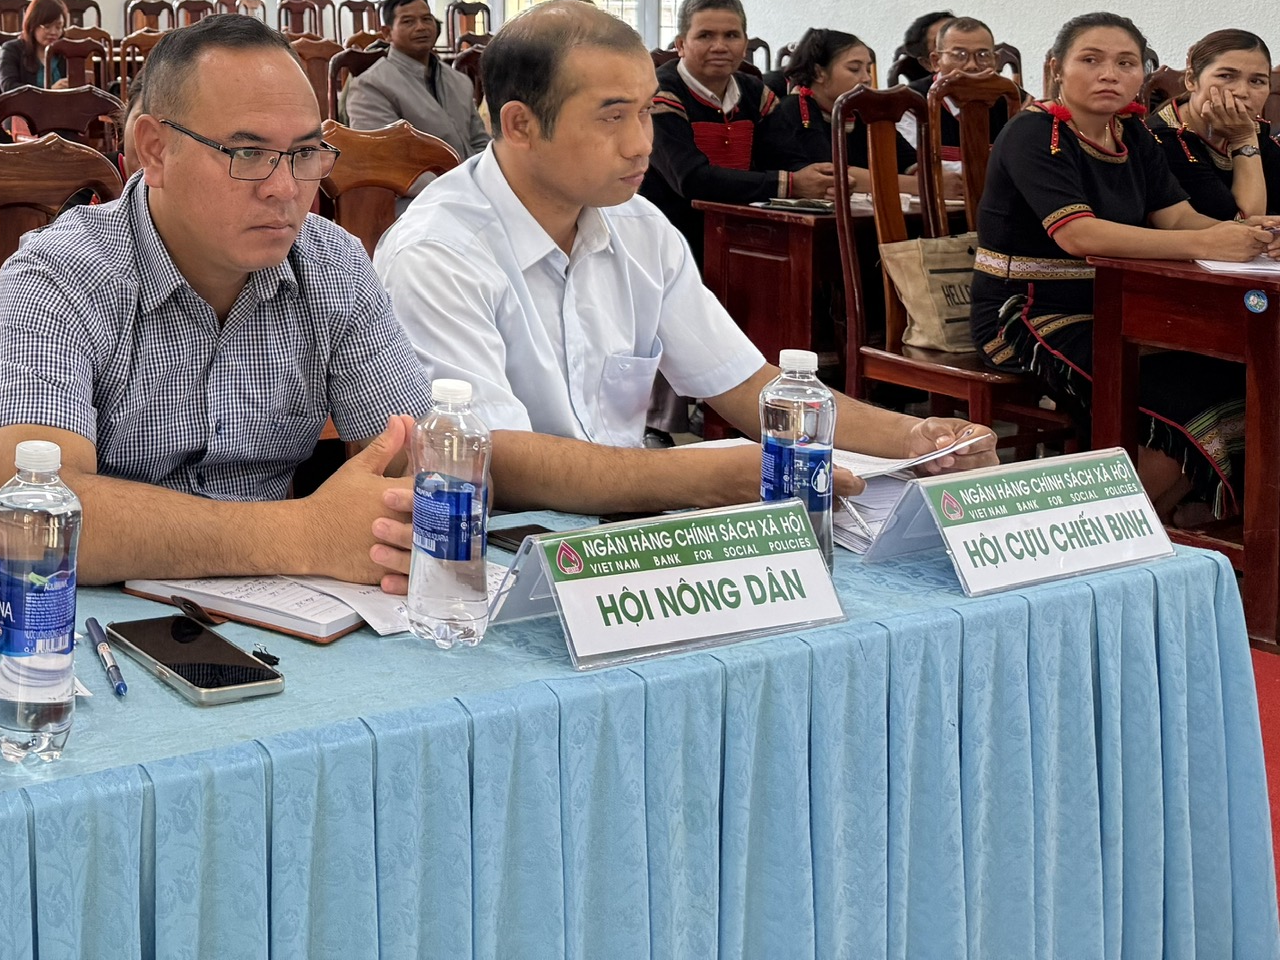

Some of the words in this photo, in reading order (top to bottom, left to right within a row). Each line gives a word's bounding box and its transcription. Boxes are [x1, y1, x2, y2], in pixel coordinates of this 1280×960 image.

[959, 483, 997, 506] NGÂN
[997, 477, 1031, 499] HÀNG
[1030, 473, 1065, 494] CHÍNH
[1065, 467, 1094, 489] SÁCH
[1093, 464, 1111, 484] XÃ
[1110, 460, 1132, 481] HỘI
[1016, 500, 1039, 511] BANK
[1048, 495, 1064, 506] FOR
[1070, 490, 1098, 503] SOCIAL
[1105, 483, 1138, 497] POLICIES
[582, 535, 628, 559] NGÂN
[628, 529, 672, 553] HÀNG
[674, 523, 719, 547] CHÍNH
[721, 516, 756, 542] SÁCH
[757, 513, 780, 536] XÃ
[780, 511, 806, 534] HỘI
[653, 553, 682, 567] BANK
[694, 548, 713, 562] FOR
[723, 542, 759, 558] SOCIAL
[768, 537, 812, 553] POLICIES
[963, 532, 1007, 569] HỘI
[1005, 526, 1050, 562] CỰU
[1049, 510, 1110, 553] CHIẾN
[1105, 508, 1154, 543] BINH
[596, 587, 655, 628] HỘI
[654, 577, 742, 619] NÔNG
[743, 566, 807, 607] DÂN
